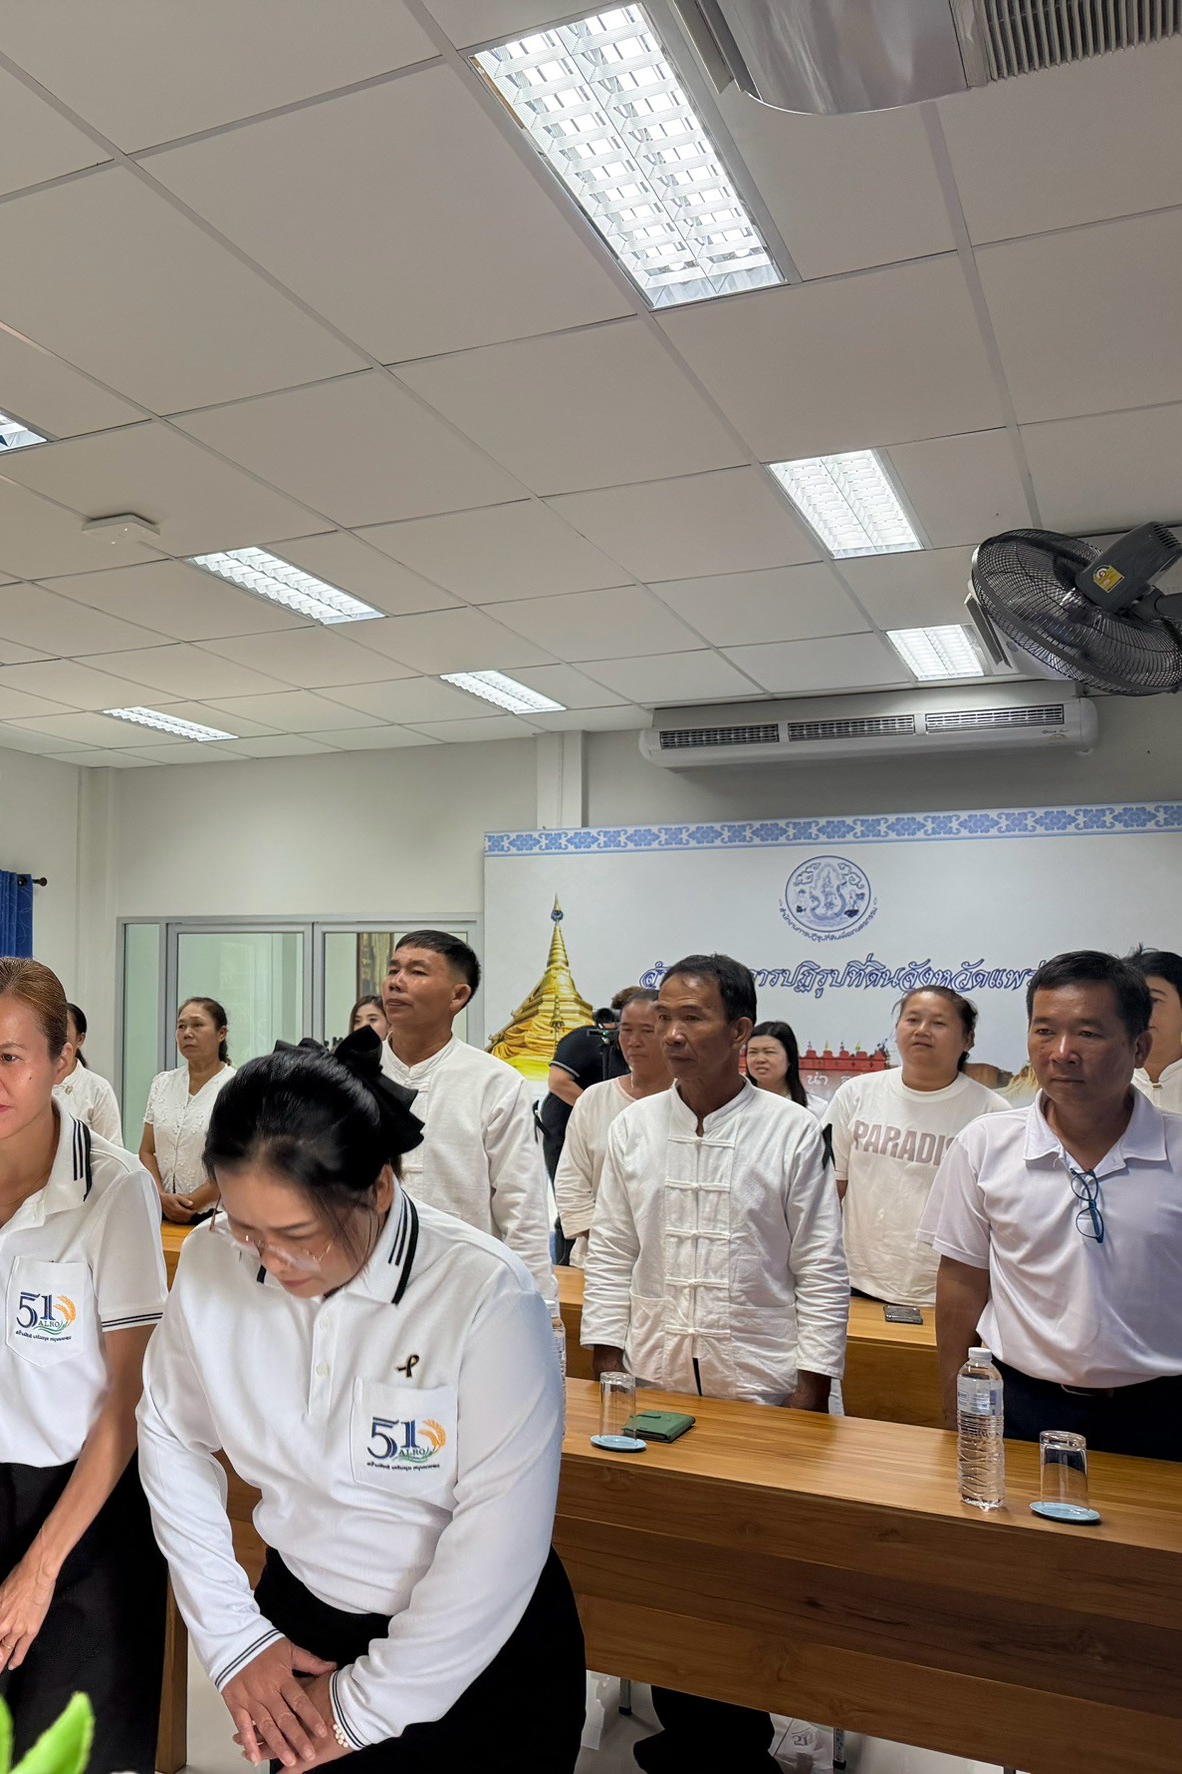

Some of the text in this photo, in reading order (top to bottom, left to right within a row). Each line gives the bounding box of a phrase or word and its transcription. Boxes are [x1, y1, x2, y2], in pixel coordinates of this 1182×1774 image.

[16, 1292, 56, 1329] 51
[38, 1320, 60, 1328] ALRO
[367, 1416, 420, 1460] 51
[399, 1448, 426, 1457] ALRO
